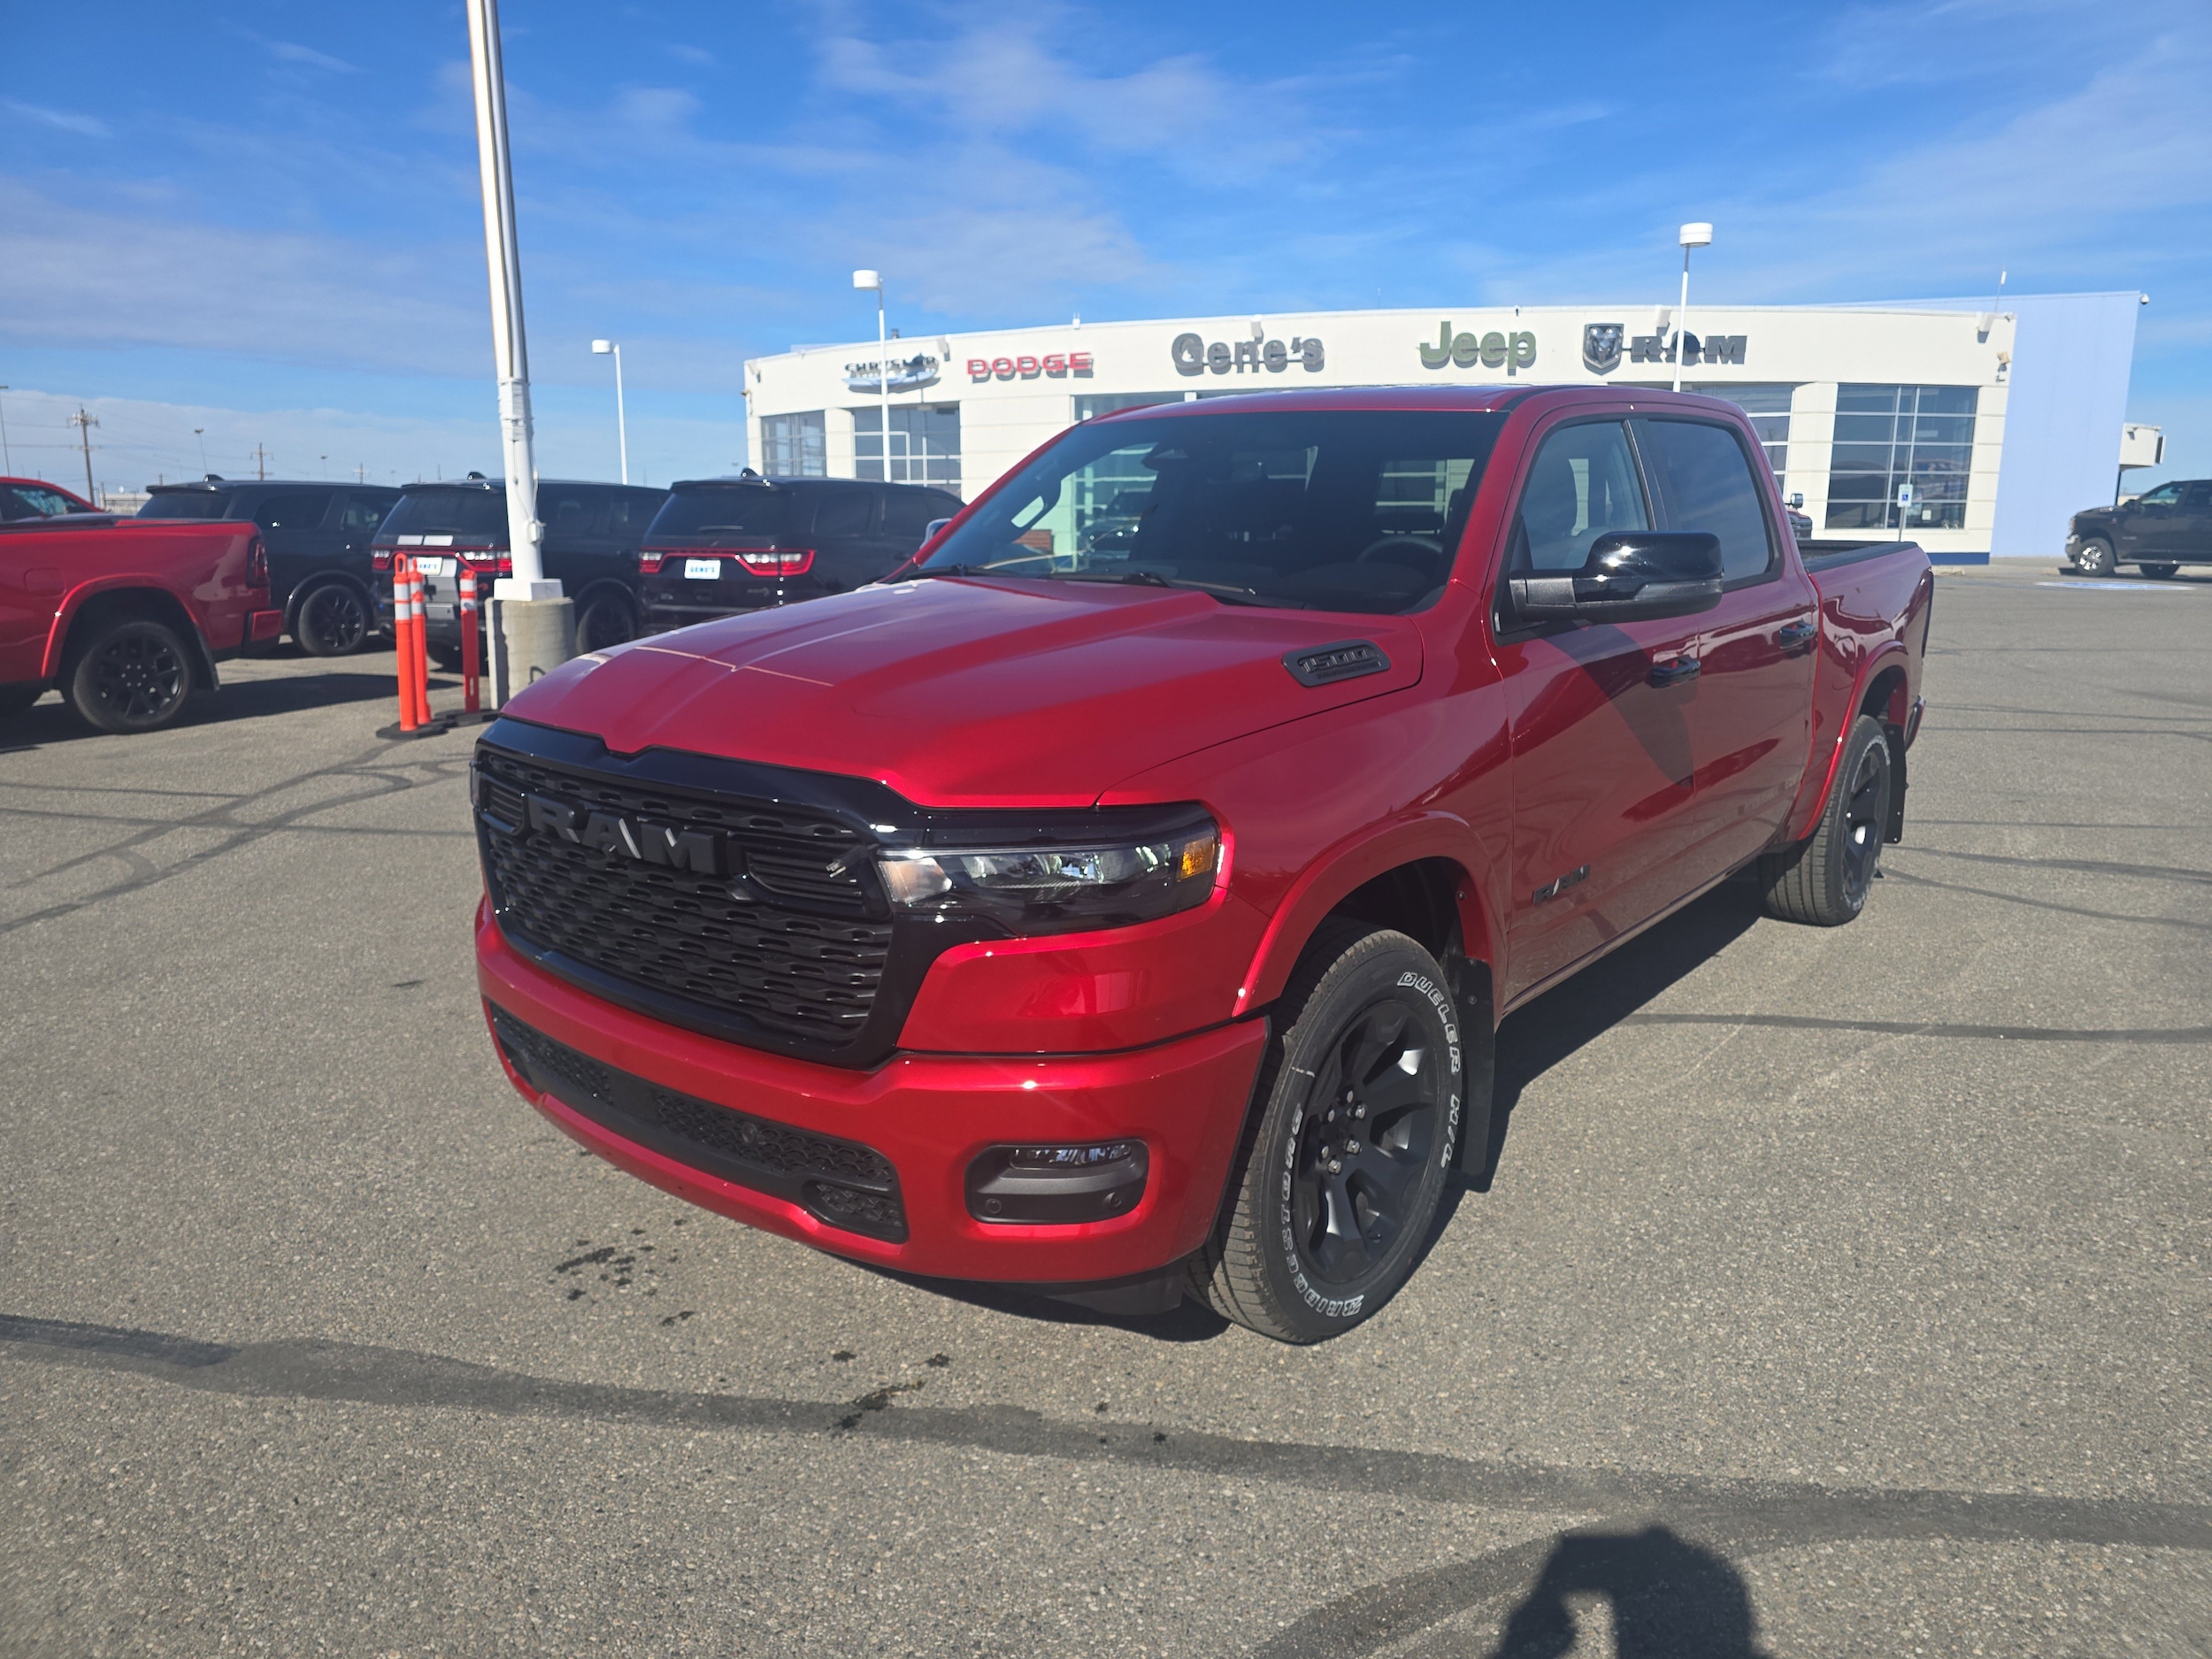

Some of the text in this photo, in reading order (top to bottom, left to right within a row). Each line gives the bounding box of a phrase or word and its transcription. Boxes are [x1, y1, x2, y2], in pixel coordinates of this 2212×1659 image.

[967, 352, 1092, 377] DODGE
[1171, 333, 1325, 374] Gene's
[1420, 321, 1537, 372] Jeep
[528, 794, 716, 875] RAM
[1532, 863, 1590, 907] RAM
[1397, 972, 1460, 1075] DUELER
[1280, 1103, 1364, 1317] BRIDGESTONE
